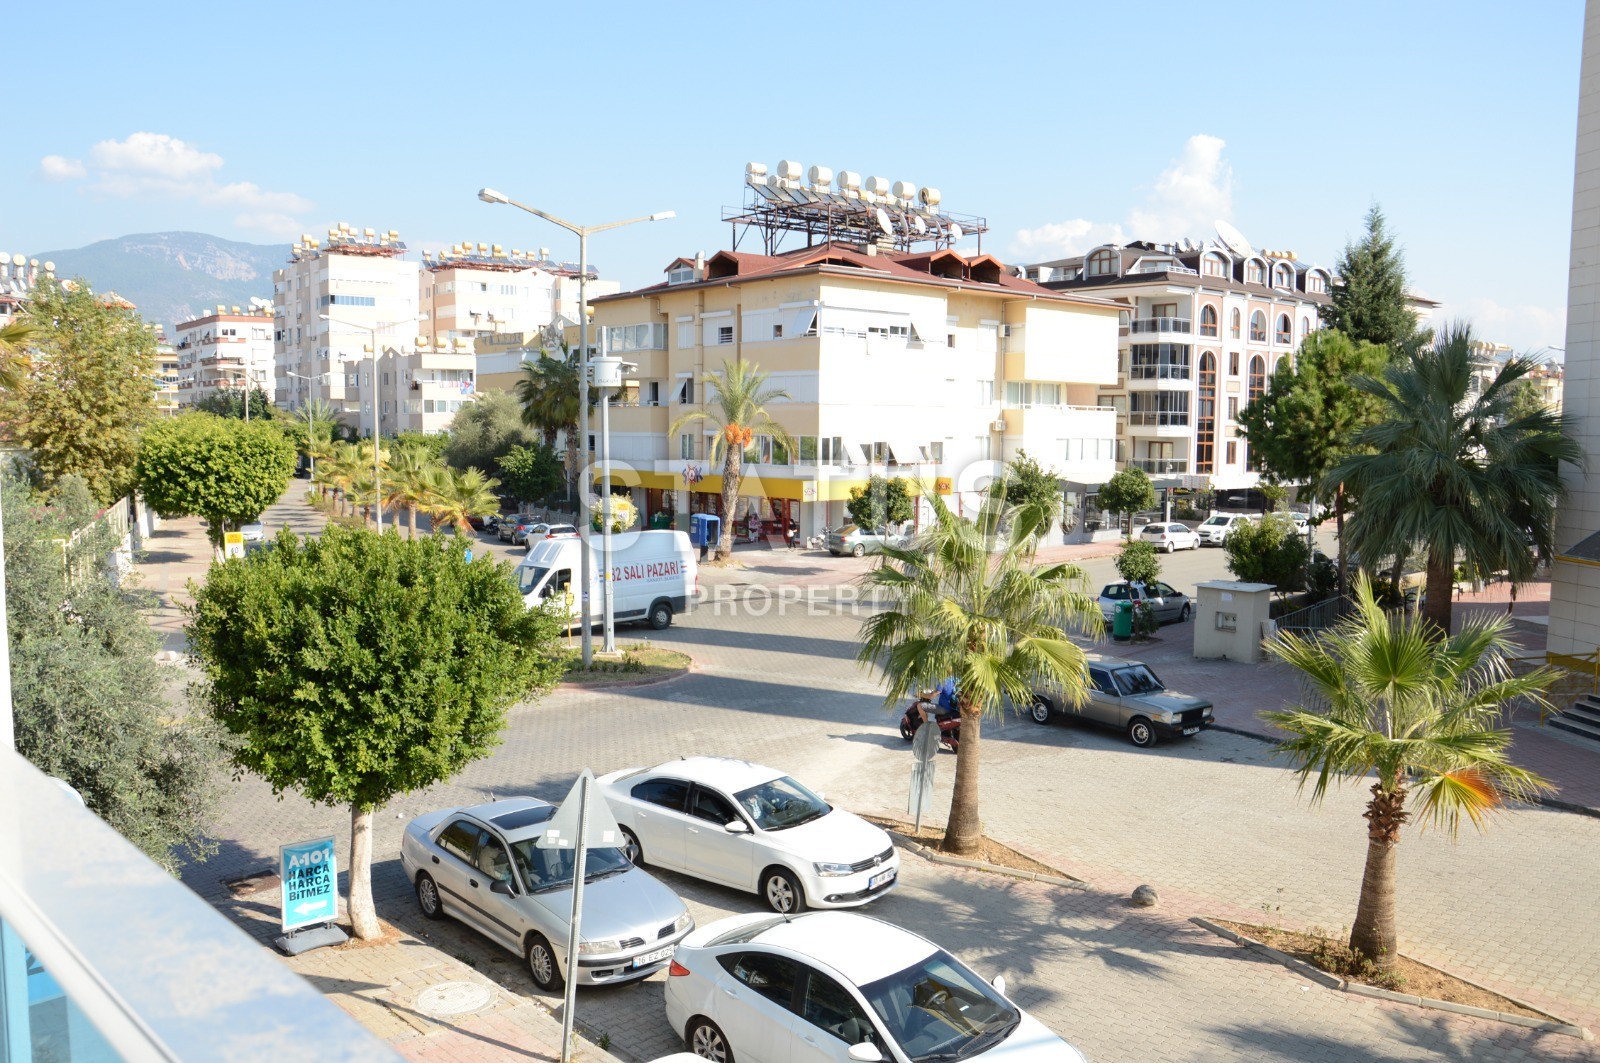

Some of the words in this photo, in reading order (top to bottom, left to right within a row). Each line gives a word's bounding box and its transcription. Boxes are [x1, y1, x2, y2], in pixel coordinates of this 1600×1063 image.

[647, 561, 679, 577] PAZARI
[288, 864, 330, 880] HARCA
[288, 877, 331, 891] HARCA
